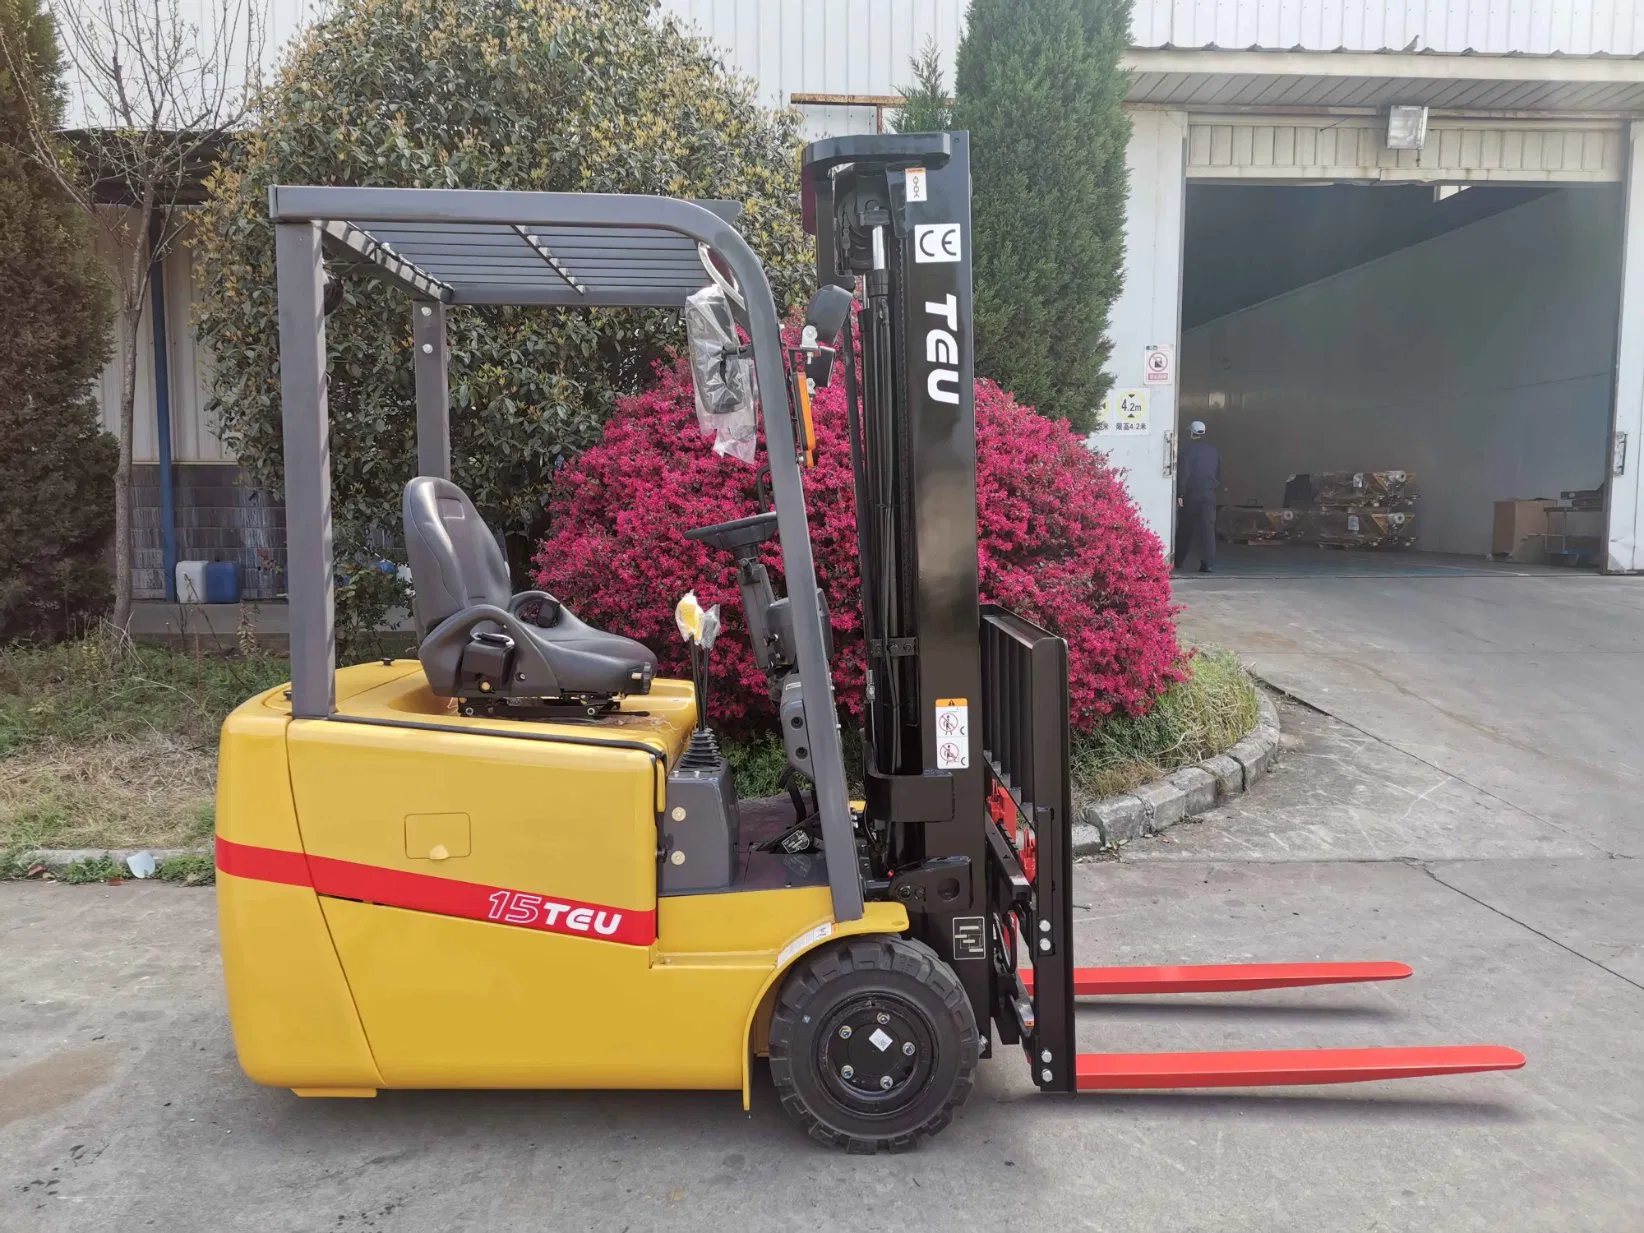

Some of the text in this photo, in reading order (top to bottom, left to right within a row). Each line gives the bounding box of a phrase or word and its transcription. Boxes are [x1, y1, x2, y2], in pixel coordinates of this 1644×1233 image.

[919, 228, 957, 257] CE
[924, 293, 960, 405] TEU
[1121, 398, 1142, 412] 4.2m
